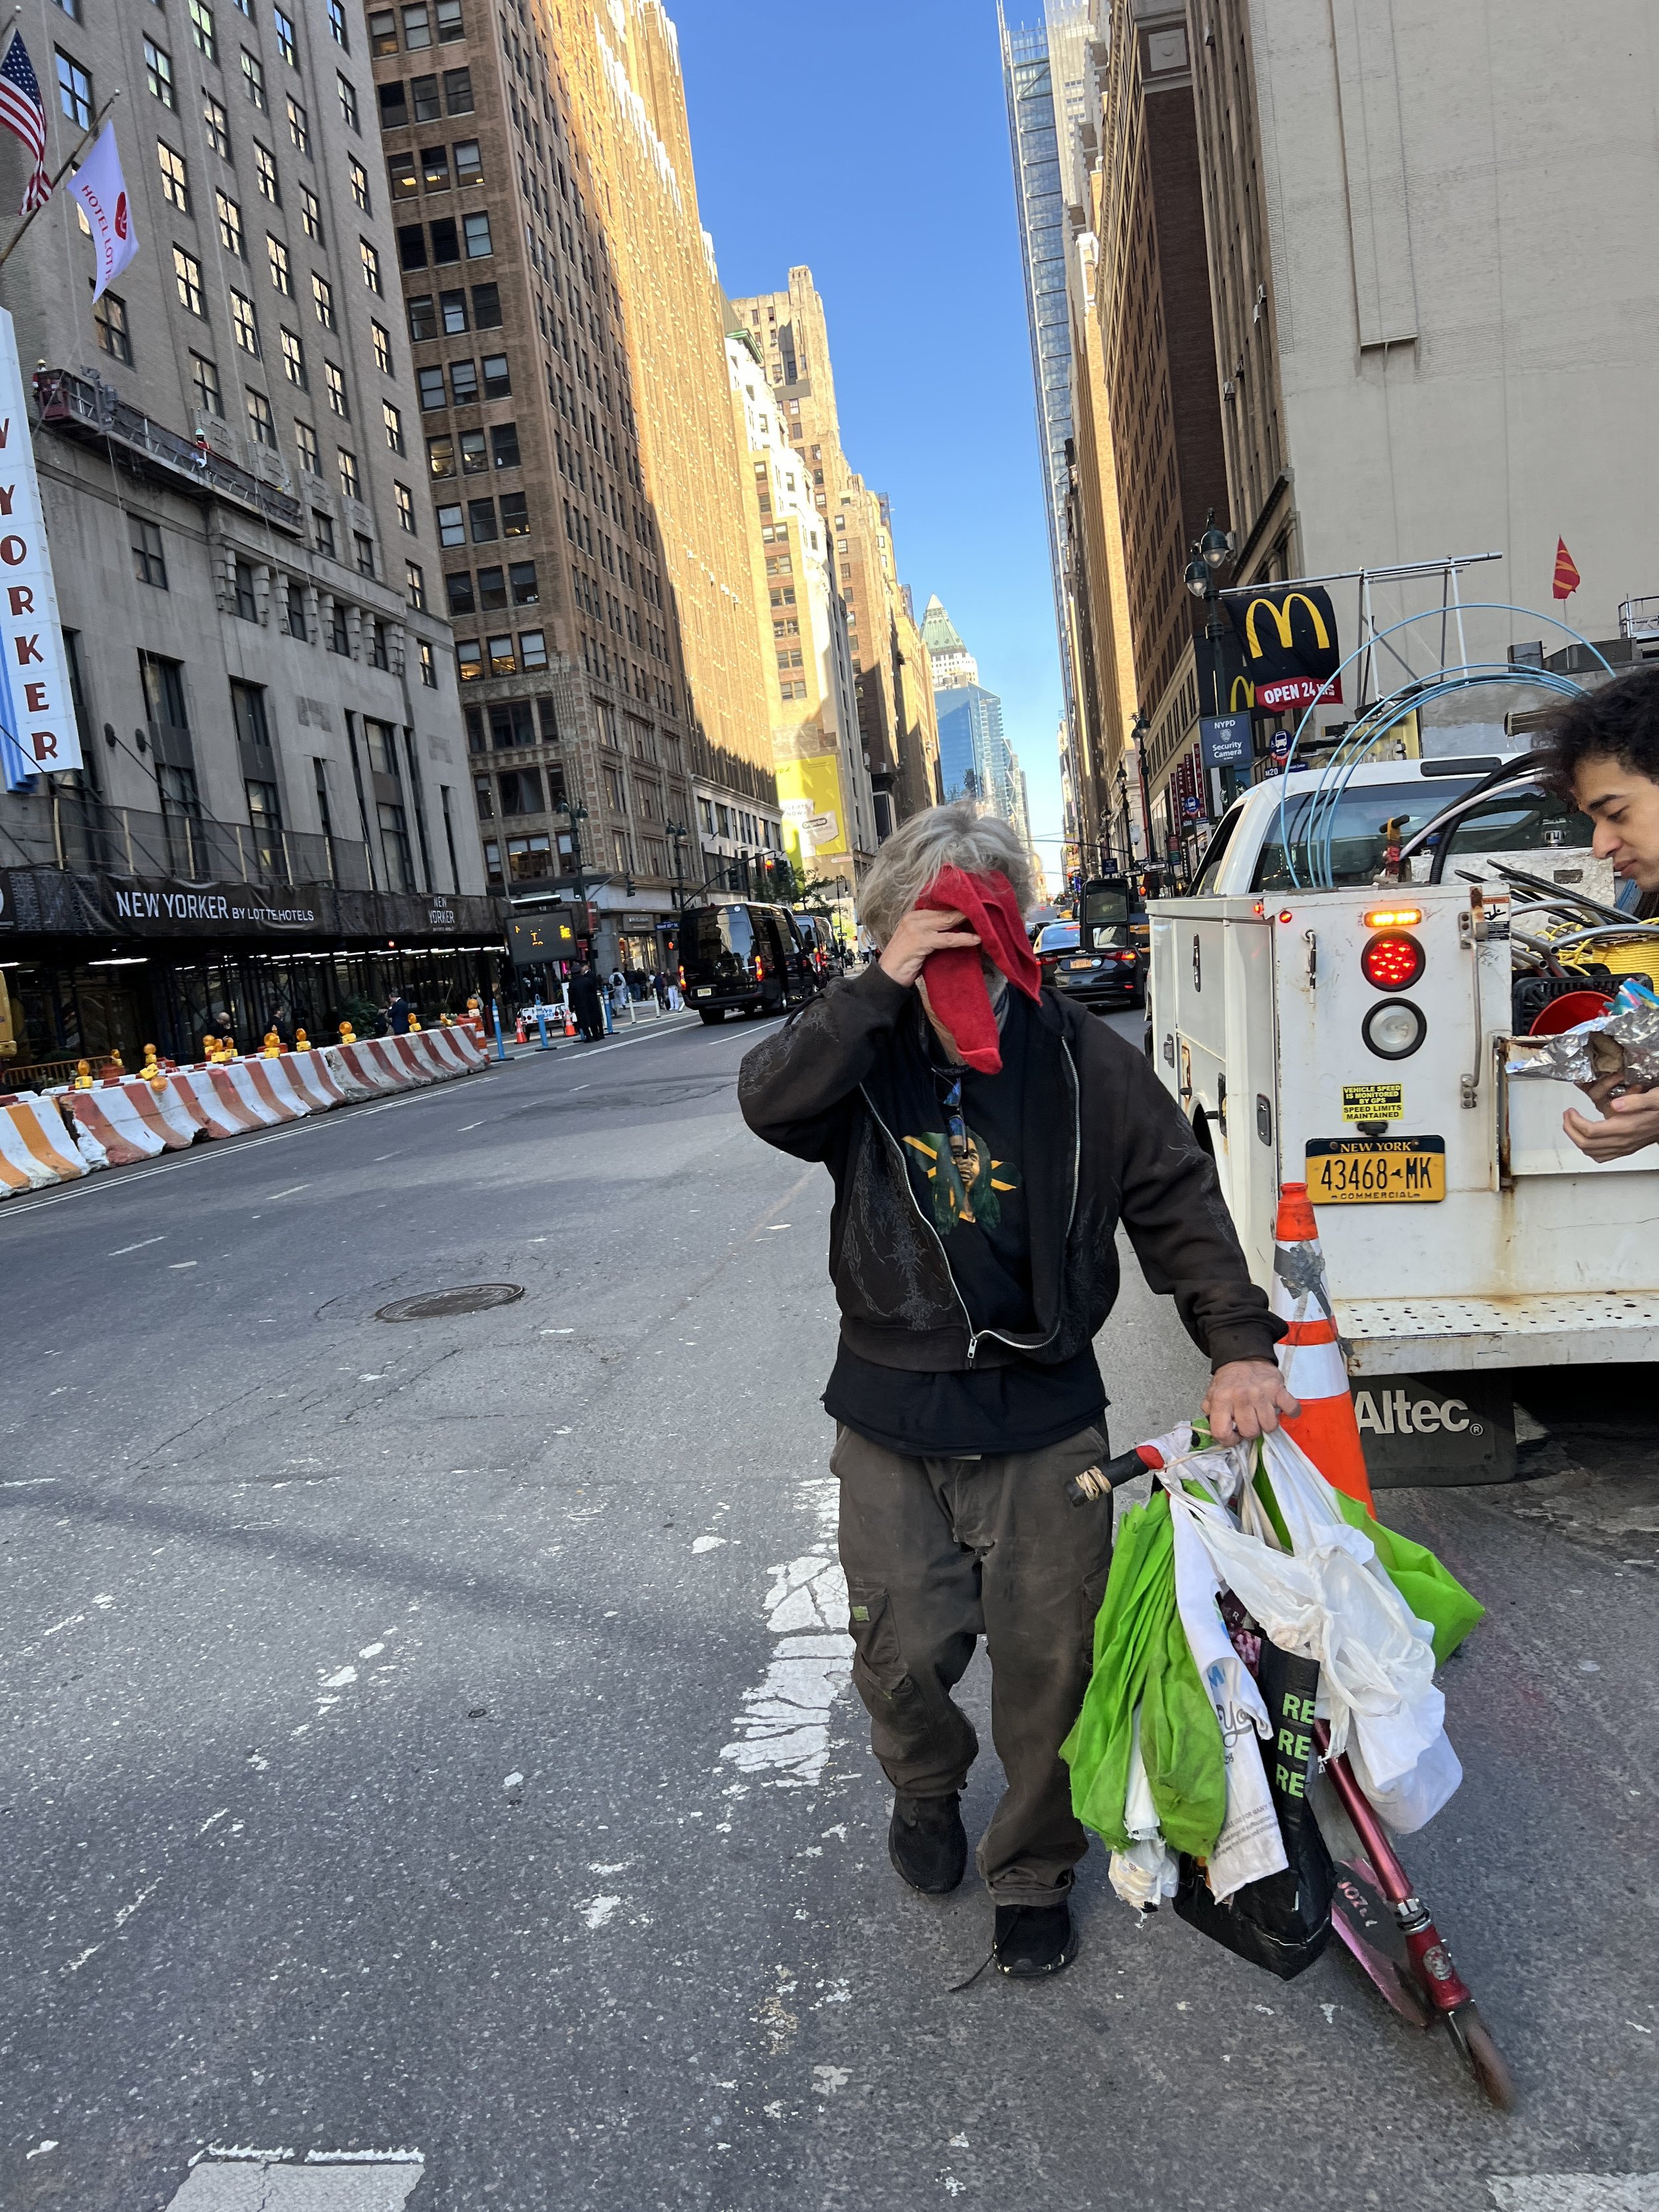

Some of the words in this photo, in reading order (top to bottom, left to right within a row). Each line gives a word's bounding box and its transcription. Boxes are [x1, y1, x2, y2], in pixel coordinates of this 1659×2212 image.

[82, 185, 108, 237] HOTEL
[1264, 684, 1299, 704] OPEN
[1302, 682, 1316, 697] 24
[1214, 720, 1236, 729] NYPD
[1212, 741, 1242, 752] Security
[1214, 749, 1242, 759] Camera
[1195, 747, 1204, 814] STAPLES
[116, 891, 159, 918] NEW
[163, 893, 229, 919] YORKER
[232, 907, 245, 919] BY
[248, 909, 277, 921] LOTTE
[279, 910, 314, 921] HOTELS
[433, 897, 447, 907] NEW
[429, 910, 455, 923] YORKER
[1340, 1143, 1373, 1153] NEW
[1376, 1142, 1411, 1151] YORK
